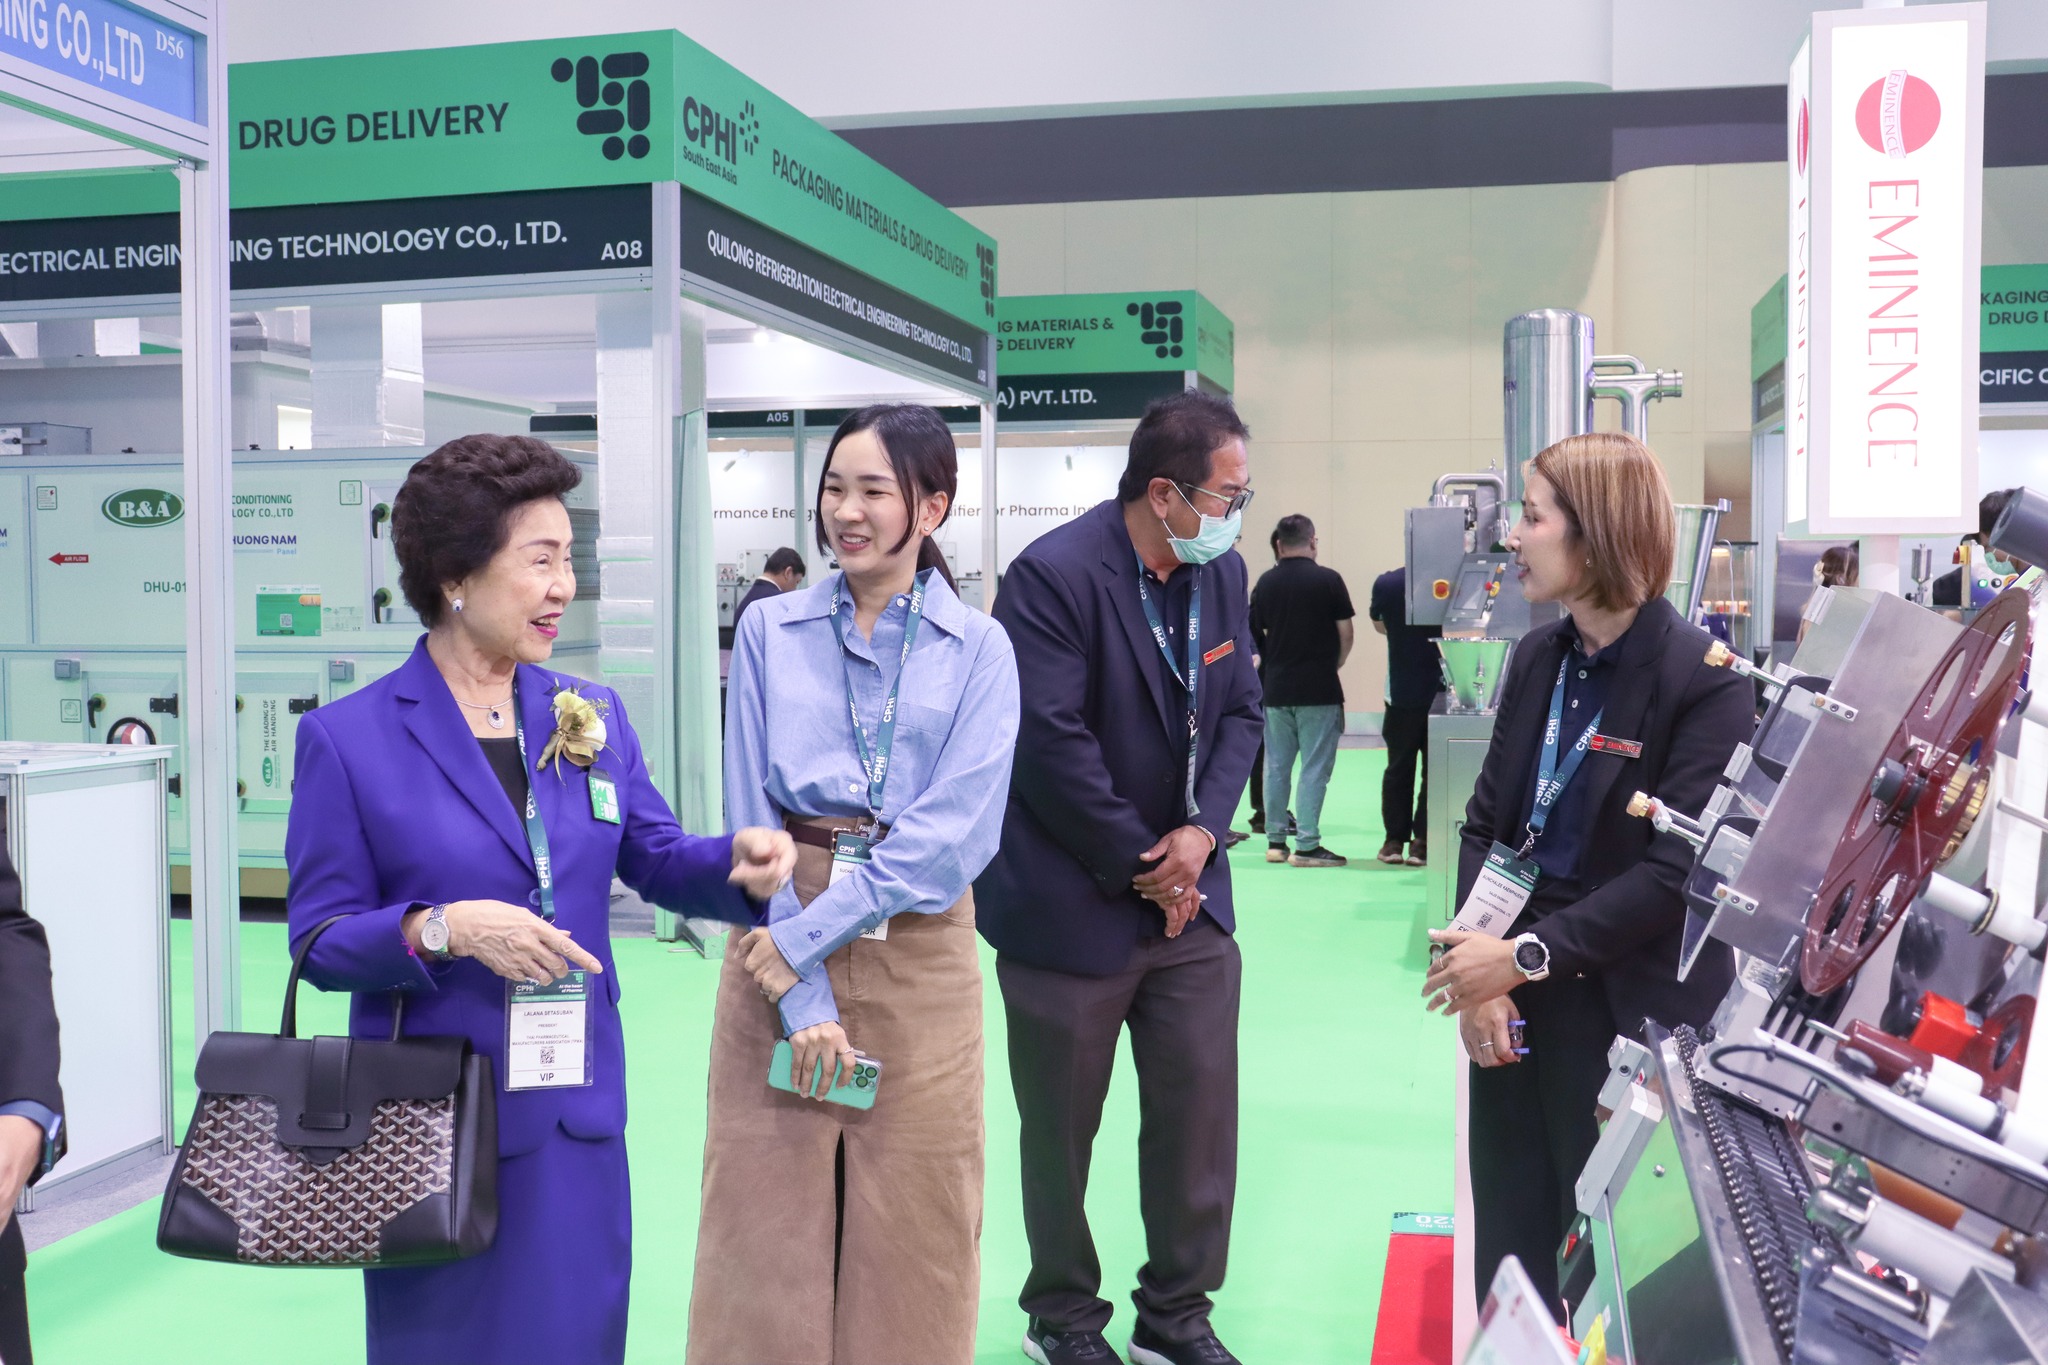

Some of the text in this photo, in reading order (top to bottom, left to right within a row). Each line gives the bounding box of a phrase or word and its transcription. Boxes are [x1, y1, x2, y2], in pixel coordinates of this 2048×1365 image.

[0, 0, 145, 86] ING CO.,LTD
[155, 29, 185, 60] D56
[239, 101, 511, 150] DRUG DELIVERY
[1884, 73, 1902, 157] EMINENCE
[683, 95, 737, 167] CPHI
[683, 145, 737, 186] South East Asia
[772, 148, 969, 281] PACKAGING MATERIALS & DRUG DELIVERY
[0, 220, 568, 275] ECTRICAL ENGINING TECHNOLOGY CO., LTD.
[600, 240, 643, 261] A08
[707, 229, 755, 270] QUILONG
[755, 252, 823, 301] REFRIGERATION
[823, 283, 866, 321] ELECTRICAL
[866, 303, 911, 338] ENGINEERING
[910, 322, 950, 354] TECHNOLOGY
[961, 345, 973, 364] LTD.
[1981, 290, 2048, 305] KAGING
[1017, 317, 1099, 333] MATERIALS
[1102, 317, 1115, 330] &
[1867, 179, 1920, 469] EMINENCE
[1988, 311, 2039, 325] DRUG
[1008, 337, 1076, 351] DELIVERY
[1980, 368, 2034, 385] CIFIC
[1020, 389, 1057, 405] PVT.
[1062, 389, 1097, 405] LTD.
[767, 412, 789, 423] A05
[118, 500, 172, 519] B&A
[713, 508, 768, 519] rmance
[1009, 504, 1069, 517] Pharma
[233, 534, 297, 545] HUONG NAM
[276, 547, 297, 555] Panel
[910, 590, 922, 614] CPHI
[1152, 625, 1167, 649] CPHI
[1189, 618, 1197, 641] CPHI
[1188, 669, 1196, 692] CPHI
[262, 699, 269, 709] OF
[849, 700, 860, 728] CPHI
[883, 697, 895, 723] CPHI
[1545, 718, 1558, 746] CPHI
[1575, 725, 1598, 751] CPHI
[862, 760, 873, 782] PHI
[873, 755, 886, 783] CPHI
[1540, 780, 1561, 807] CPHI
[839, 845, 856, 854] CPHI
[1490, 853, 1506, 865] CPHI
[537, 856, 550, 889] CPHI
[540, 1072, 554, 1081] VIP
